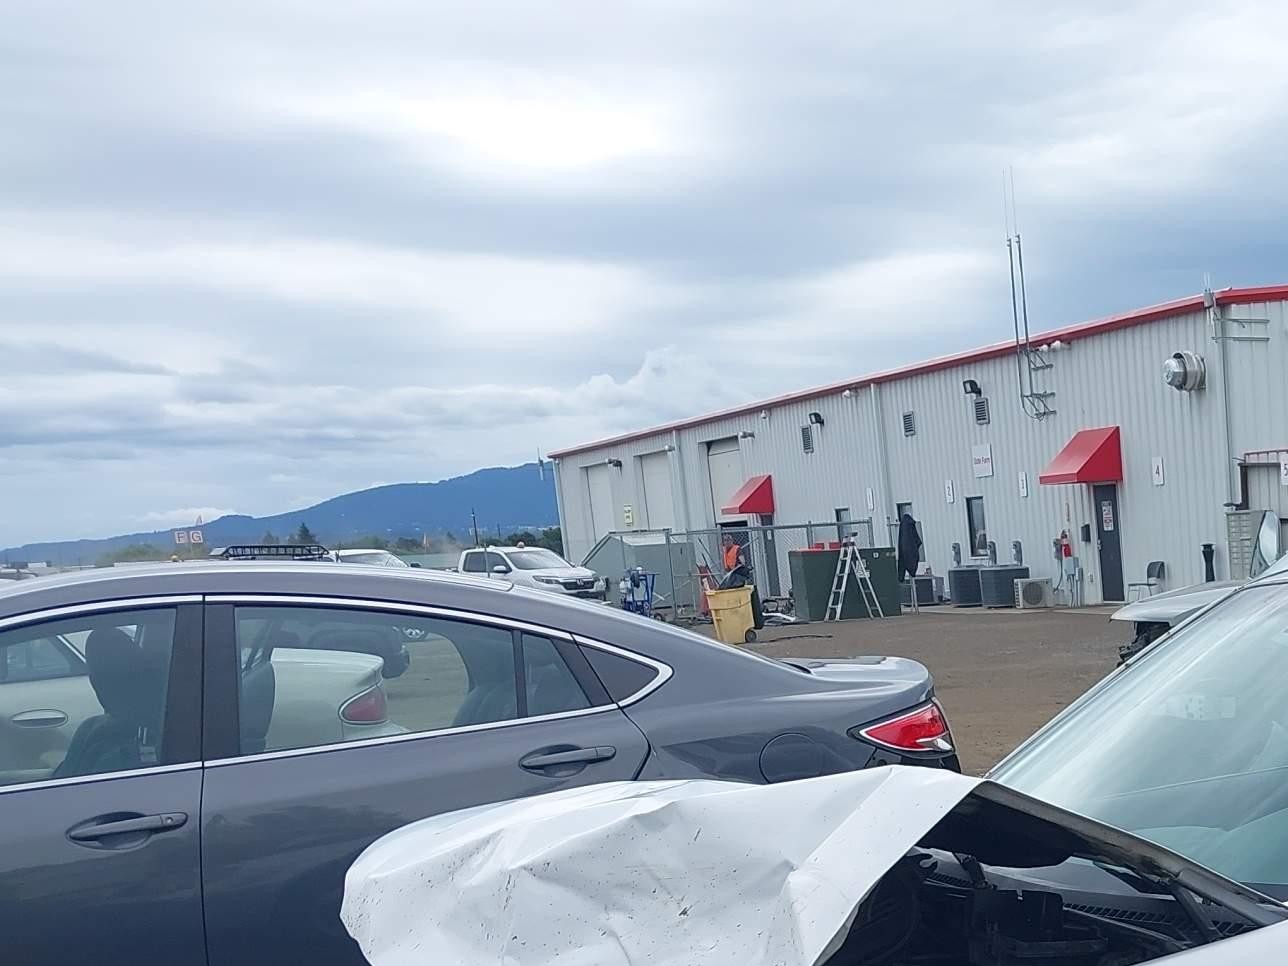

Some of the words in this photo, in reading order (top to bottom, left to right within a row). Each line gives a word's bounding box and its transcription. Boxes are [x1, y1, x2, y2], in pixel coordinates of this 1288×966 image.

[1155, 465, 1161, 477] 4
[1283, 463, 1288, 477] 5
[946, 486, 952, 497] 2
[177, 532, 184, 543] F
[191, 531, 201, 542] G
